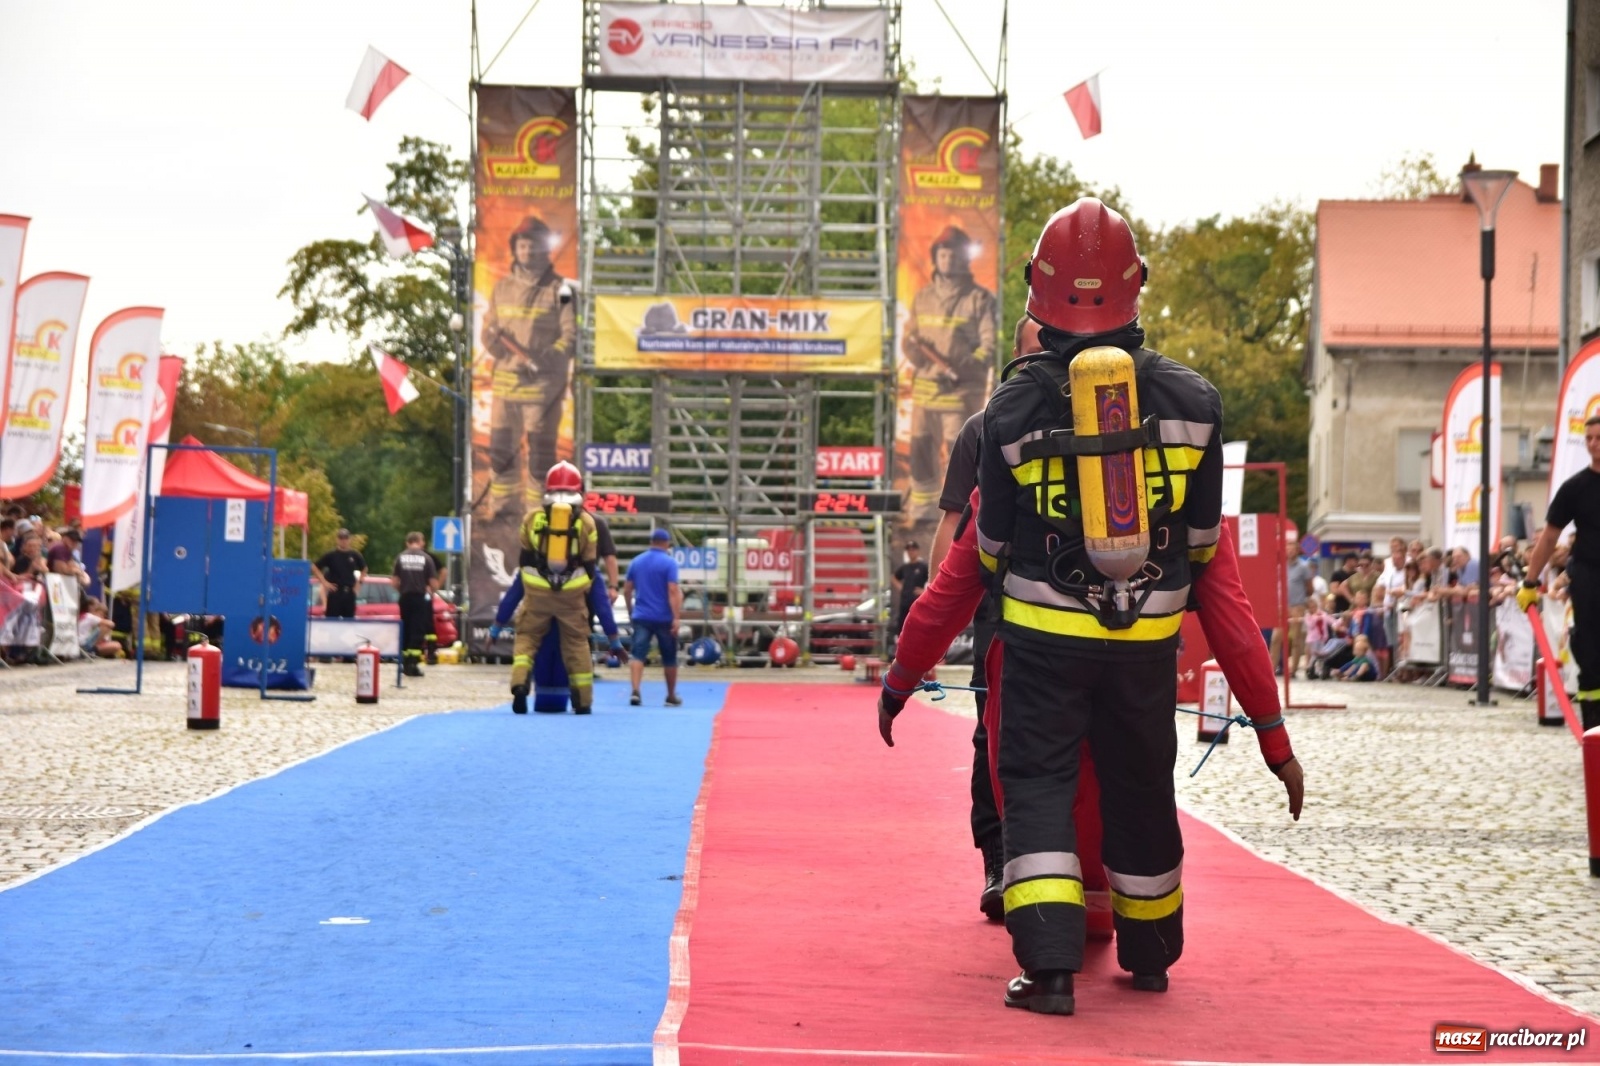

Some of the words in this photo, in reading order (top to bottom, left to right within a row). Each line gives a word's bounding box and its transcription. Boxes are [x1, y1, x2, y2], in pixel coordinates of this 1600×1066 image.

[652, 32, 820, 51] VANESSA
[830, 37, 879, 52] FM
[692, 309, 829, 332] GRAN-MIX
[585, 447, 653, 469] START
[816, 451, 883, 471] START
[747, 551, 790, 568] 006
